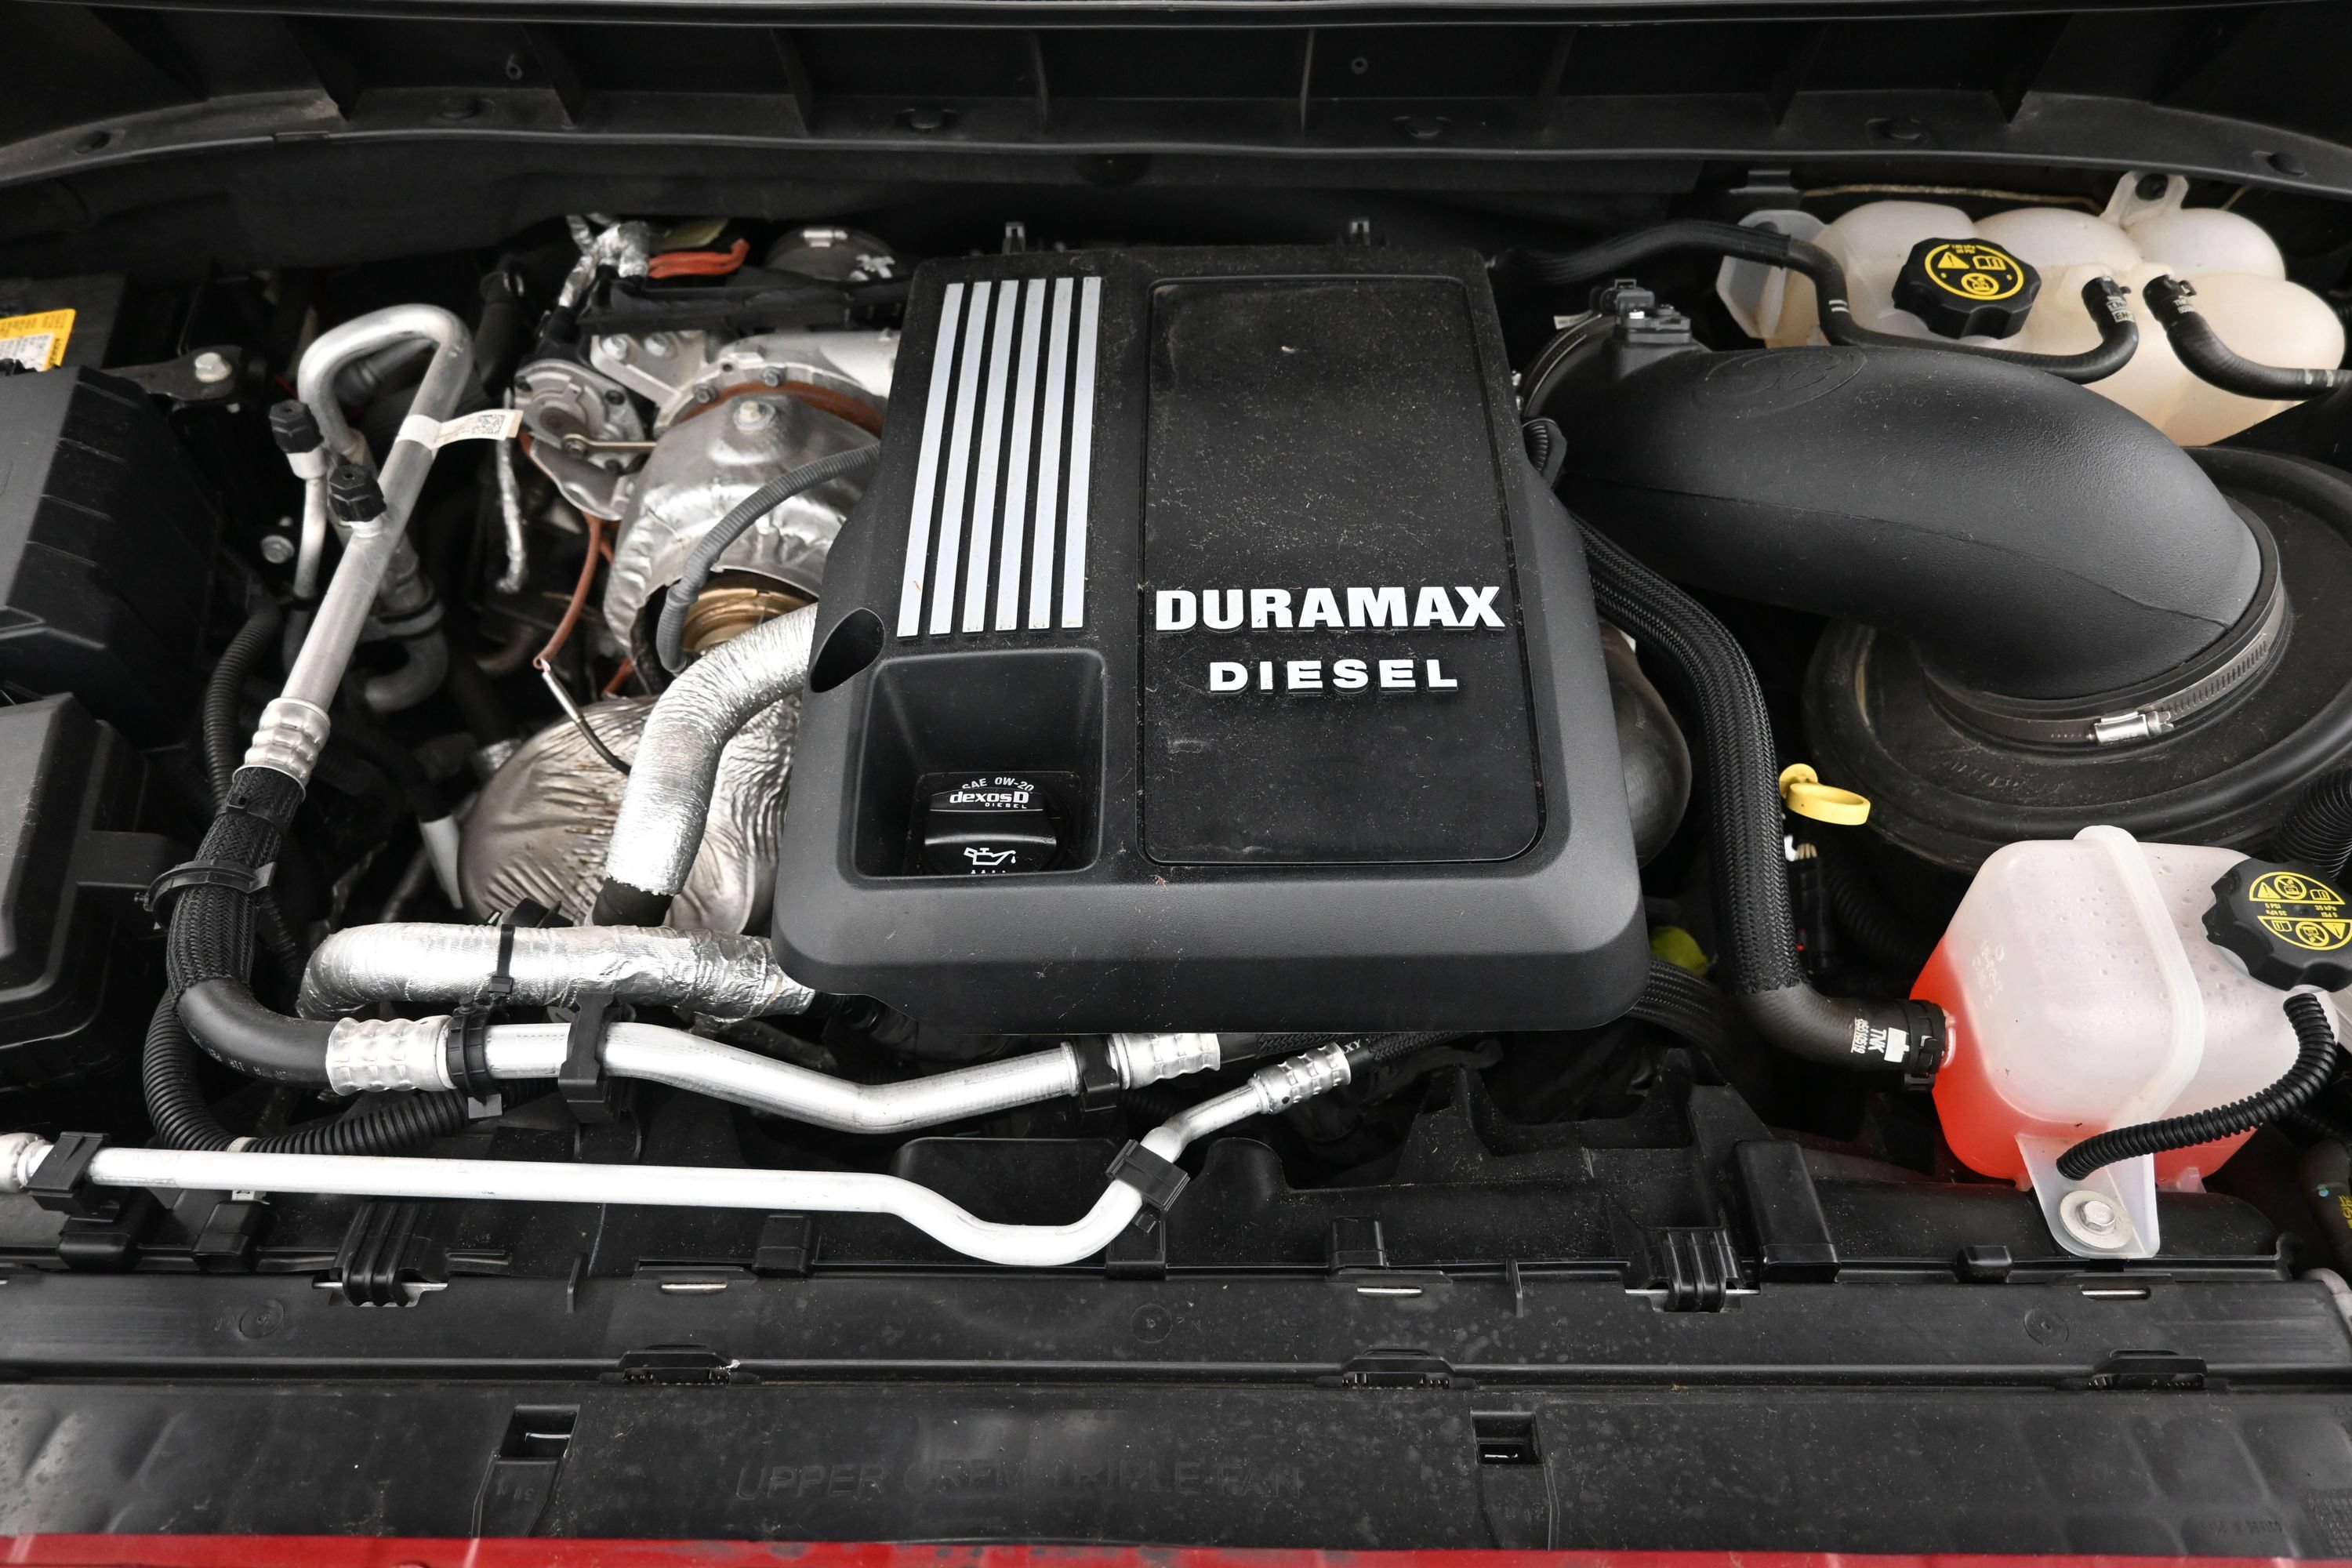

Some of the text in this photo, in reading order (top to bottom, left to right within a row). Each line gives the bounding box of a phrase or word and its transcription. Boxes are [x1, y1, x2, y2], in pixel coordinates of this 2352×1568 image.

[1156, 586, 1505, 631] DURAMAX
[1210, 659, 1458, 693] DIESEL
[949, 791, 1029, 804] dexosD
[962, 776, 1034, 792] SAE 0W-20
[1868, 1028, 1887, 1054] TNK
[735, 1463, 891, 1501] UPPER
